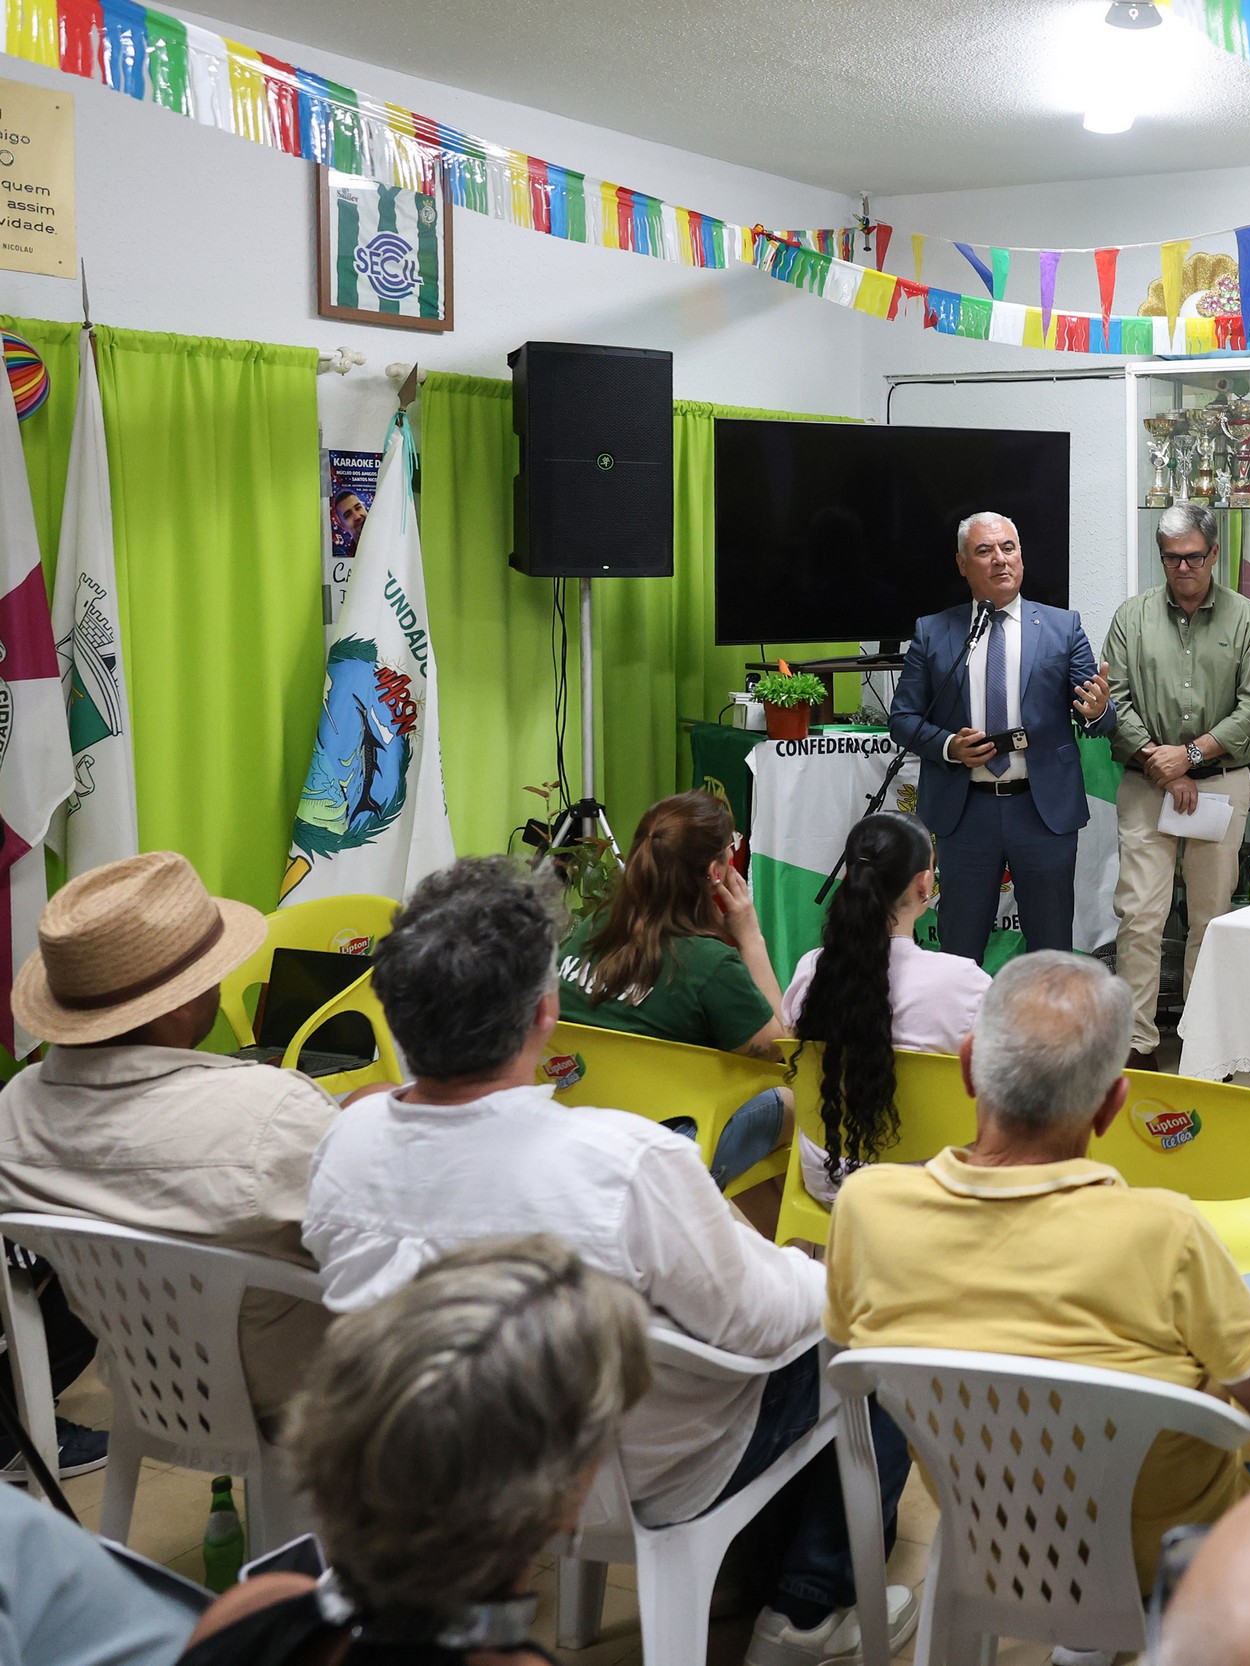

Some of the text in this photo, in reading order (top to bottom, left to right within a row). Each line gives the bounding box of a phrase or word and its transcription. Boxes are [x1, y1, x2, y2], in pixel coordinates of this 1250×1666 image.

[1, 179, 51, 197] quem
[7, 199, 55, 216] assim
[2, 243, 34, 254] NICOLAU
[355, 247, 423, 284] SECIL
[333, 457, 374, 468] KARAOKE
[775, 734, 892, 759] CONFEDERAÇÃO
[341, 940, 368, 954] Lipton
[545, 1059, 574, 1075] Lipton
[1149, 1116, 1188, 1133] Lipton
